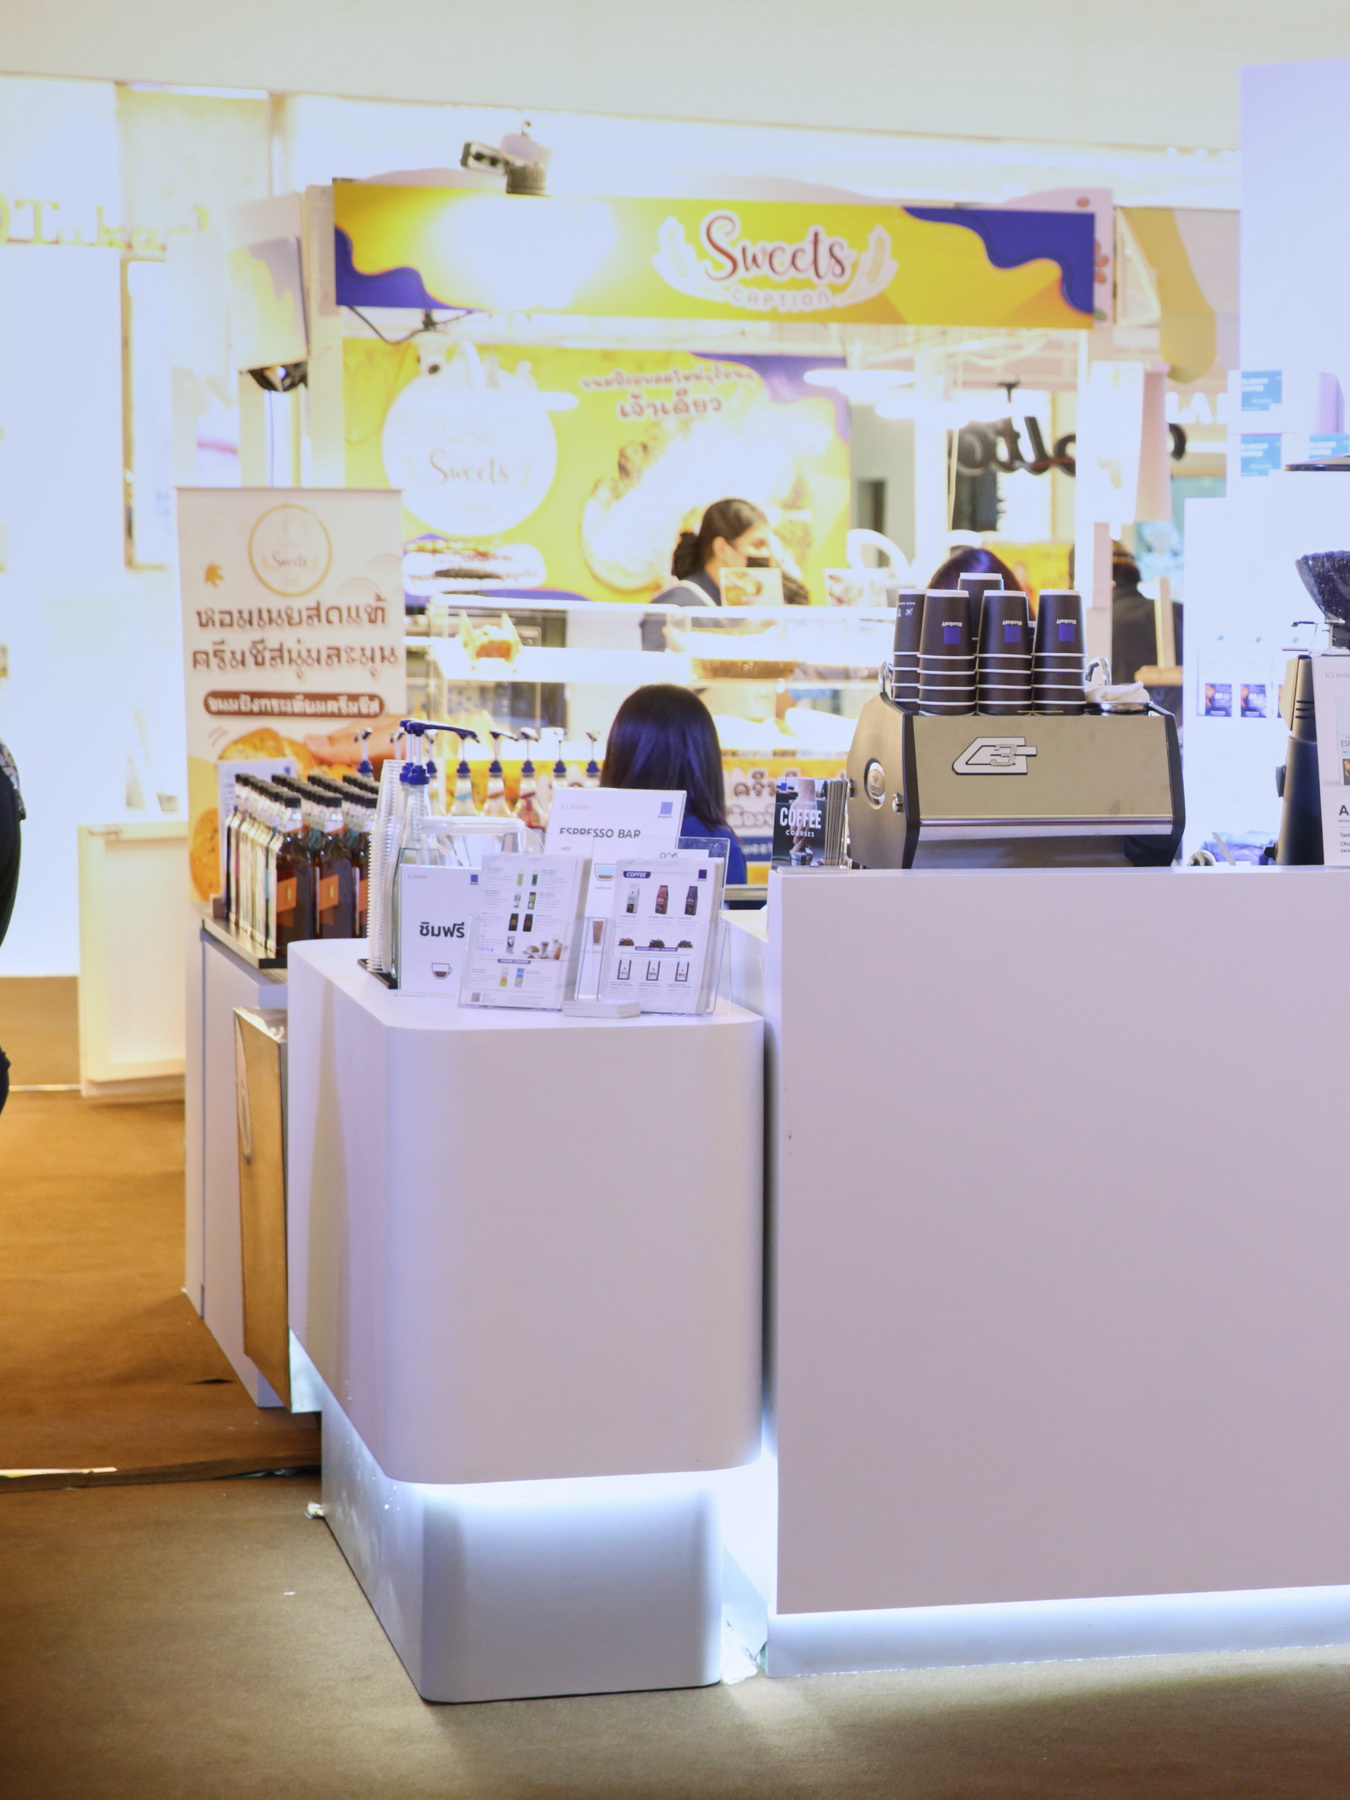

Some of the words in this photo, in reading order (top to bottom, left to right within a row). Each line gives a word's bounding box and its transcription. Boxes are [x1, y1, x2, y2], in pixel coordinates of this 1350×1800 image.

[705, 215, 847, 282] Sweets
[731, 287, 831, 309] CAPTION
[619, 386, 723, 418] เจ้าเดียว
[428, 447, 510, 485] Sweets
[196, 593, 388, 630] หอมเนยสดแท้
[192, 637, 399, 680] ครีมชีสนุ่มละมุน
[780, 807, 822, 829] COFFEE
[559, 827, 614, 839] ESPRESSO
[617, 828, 641, 839] BAR
[785, 829, 815, 838] COURSES
[419, 921, 465, 939] ชิมฟรี
